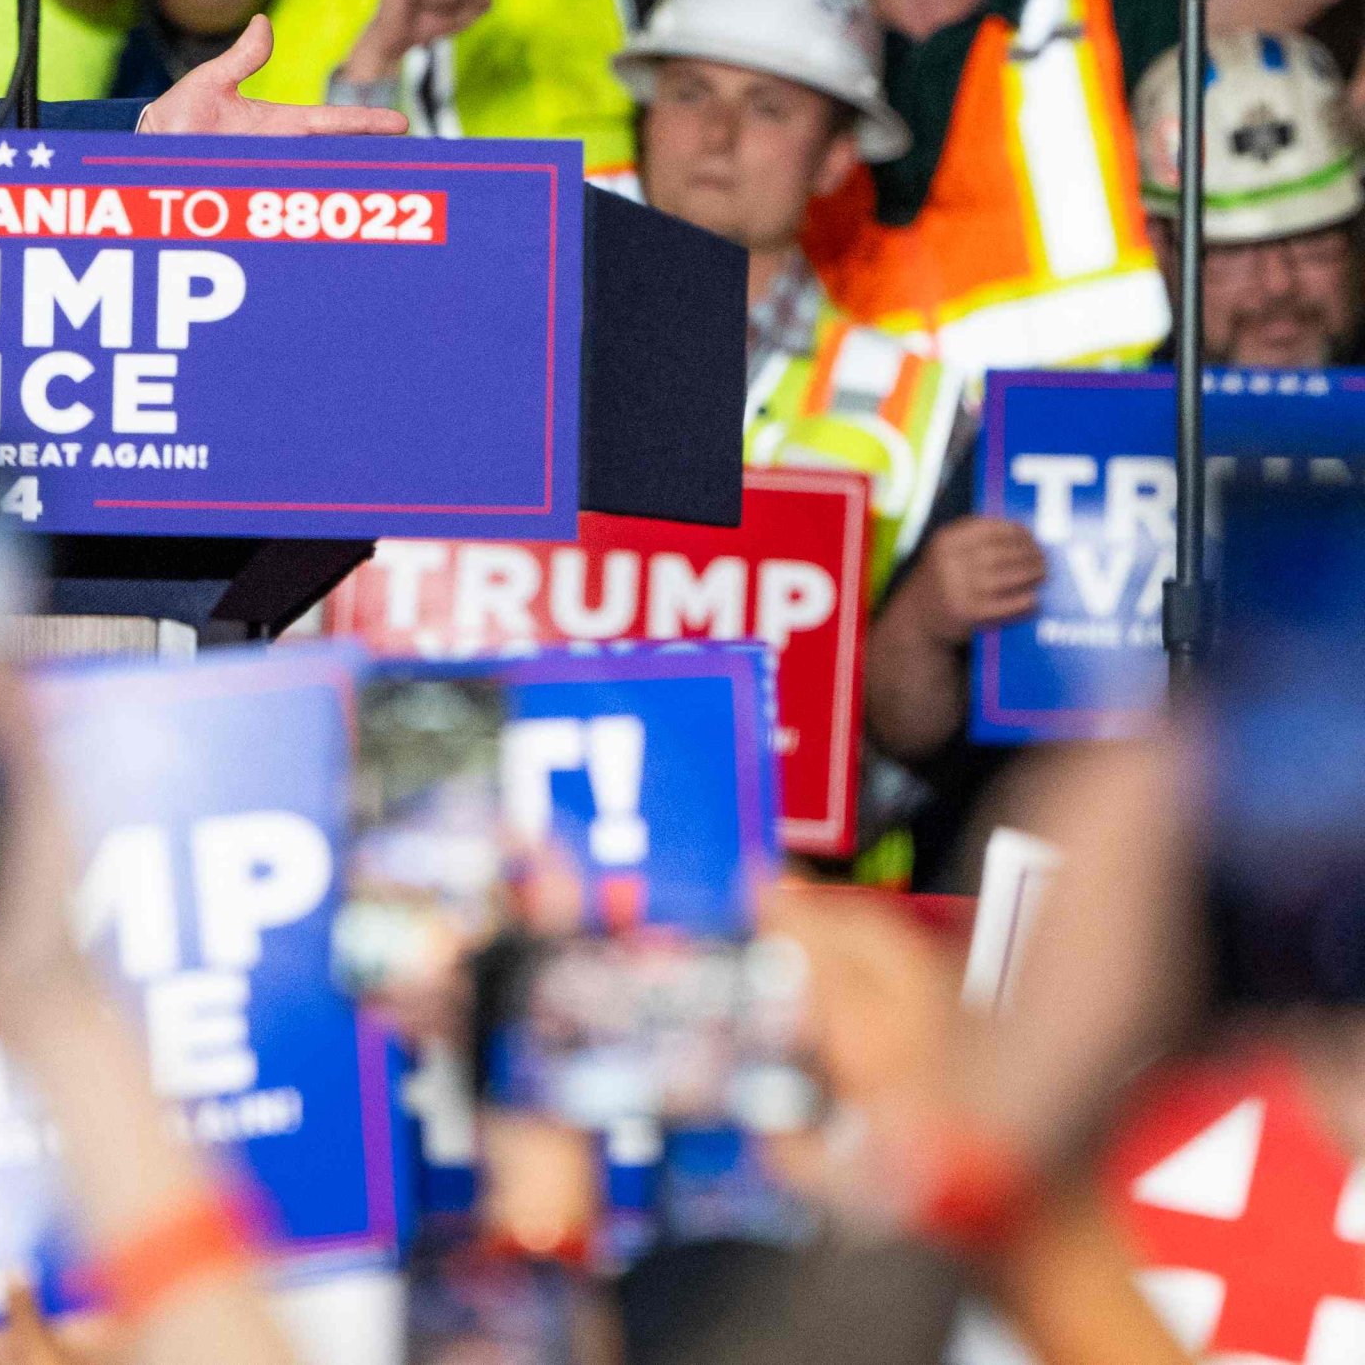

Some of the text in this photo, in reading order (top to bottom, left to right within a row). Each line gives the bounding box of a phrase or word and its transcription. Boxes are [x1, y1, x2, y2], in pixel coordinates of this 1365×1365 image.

[149, 189, 230, 237] TO
[245, 191, 435, 242] 88022
[91, 443, 210, 471] AGAIN!
[368, 539, 840, 647] TRUMP
